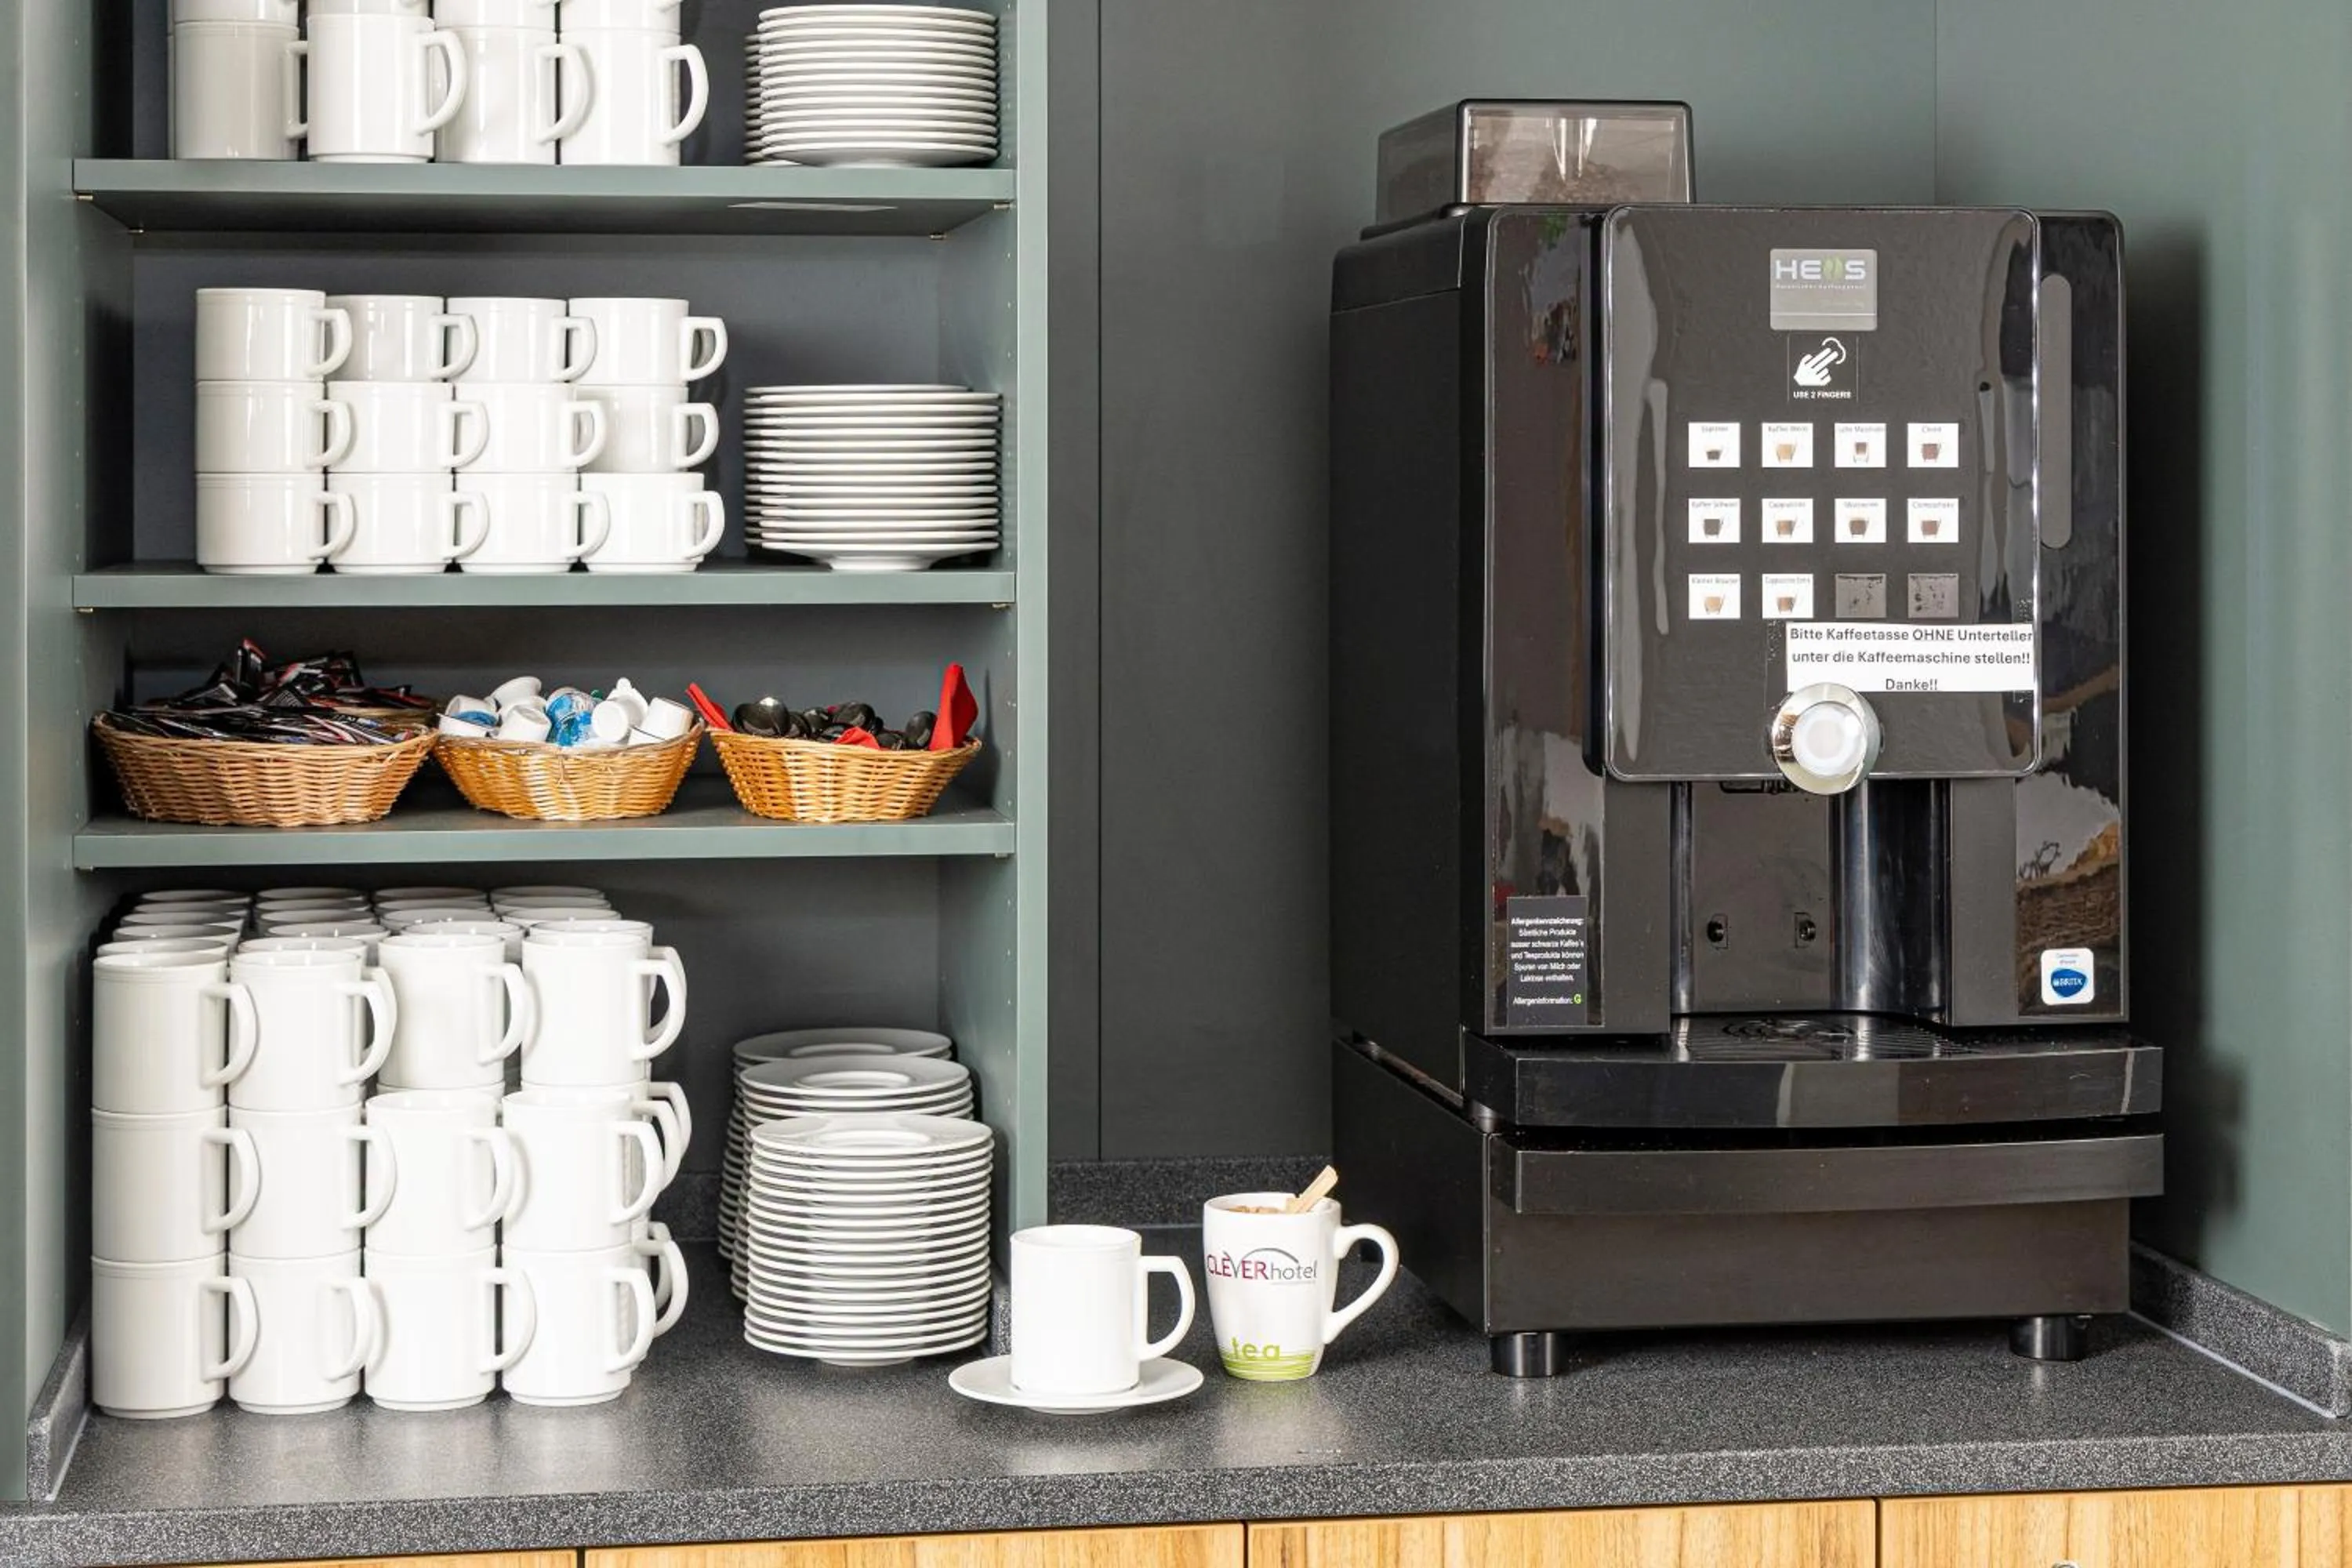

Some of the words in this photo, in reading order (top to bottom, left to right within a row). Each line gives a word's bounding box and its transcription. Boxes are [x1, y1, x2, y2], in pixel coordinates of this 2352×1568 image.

[1791, 629, 1823, 640] Bitte
[1826, 629, 1909, 641] Kaffeetasse
[1912, 630, 1955, 641] OHNE
[1958, 630, 2032, 641] Unterteller
[1792, 653, 1829, 662] unter
[1833, 652, 1854, 662] die
[1857, 652, 1970, 664] Kaffeemaschine
[1974, 652, 2031, 664] stellen!!
[1886, 678, 1938, 691] Danke!!
[1231, 1337, 1280, 1361] tea
